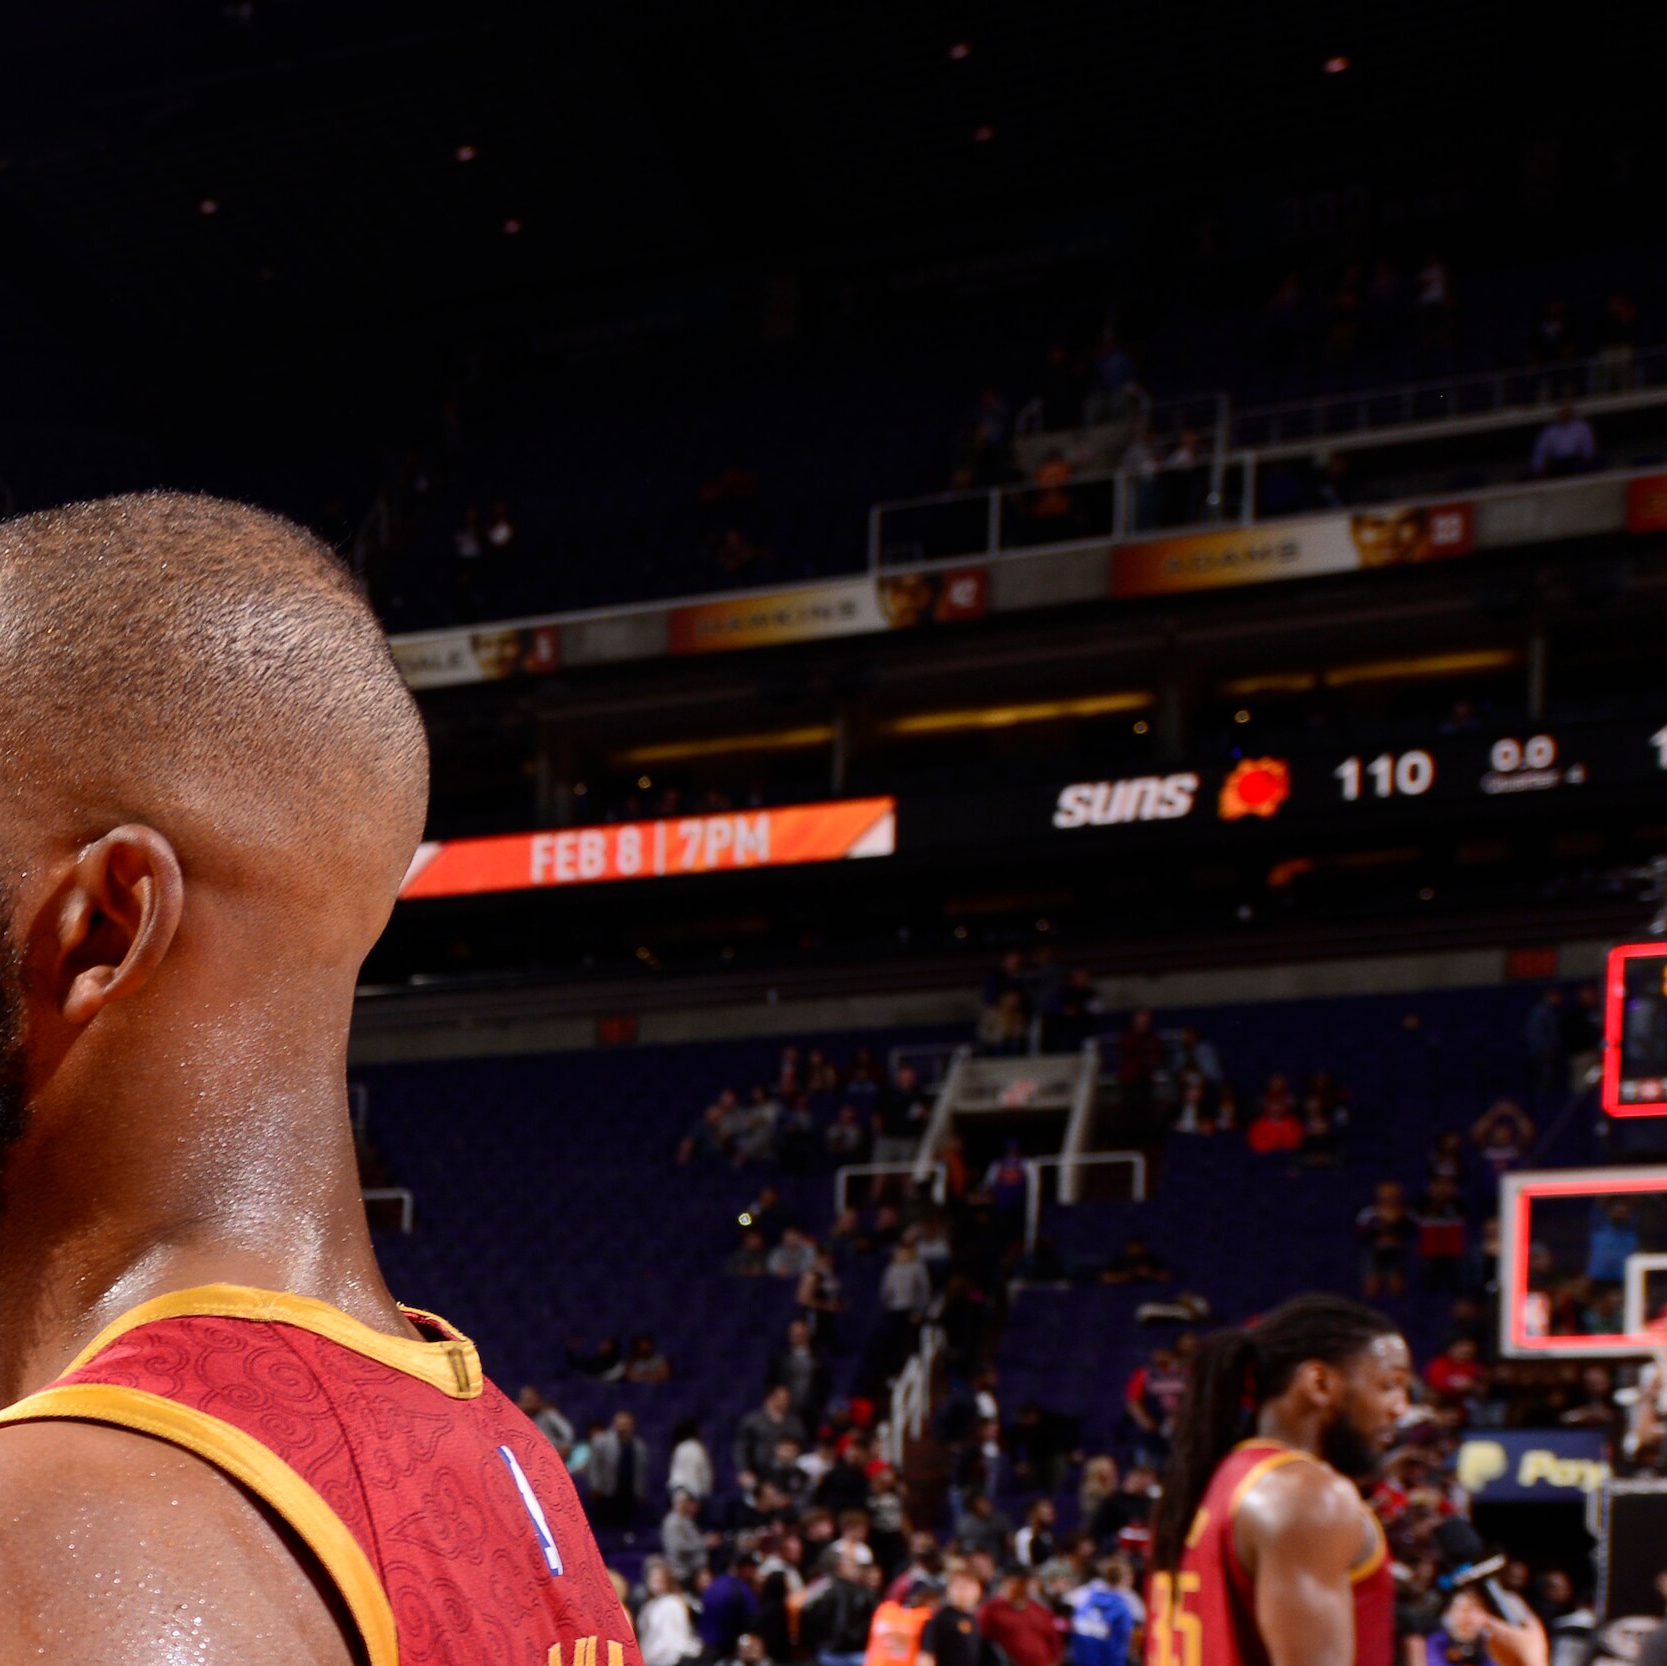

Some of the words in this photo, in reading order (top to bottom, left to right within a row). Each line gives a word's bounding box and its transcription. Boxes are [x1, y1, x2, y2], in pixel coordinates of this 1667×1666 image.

[1334, 748, 1434, 802] 110
[529, 829, 606, 885] FEB
[616, 825, 643, 877] 8
[678, 811, 771, 872] 7PM
